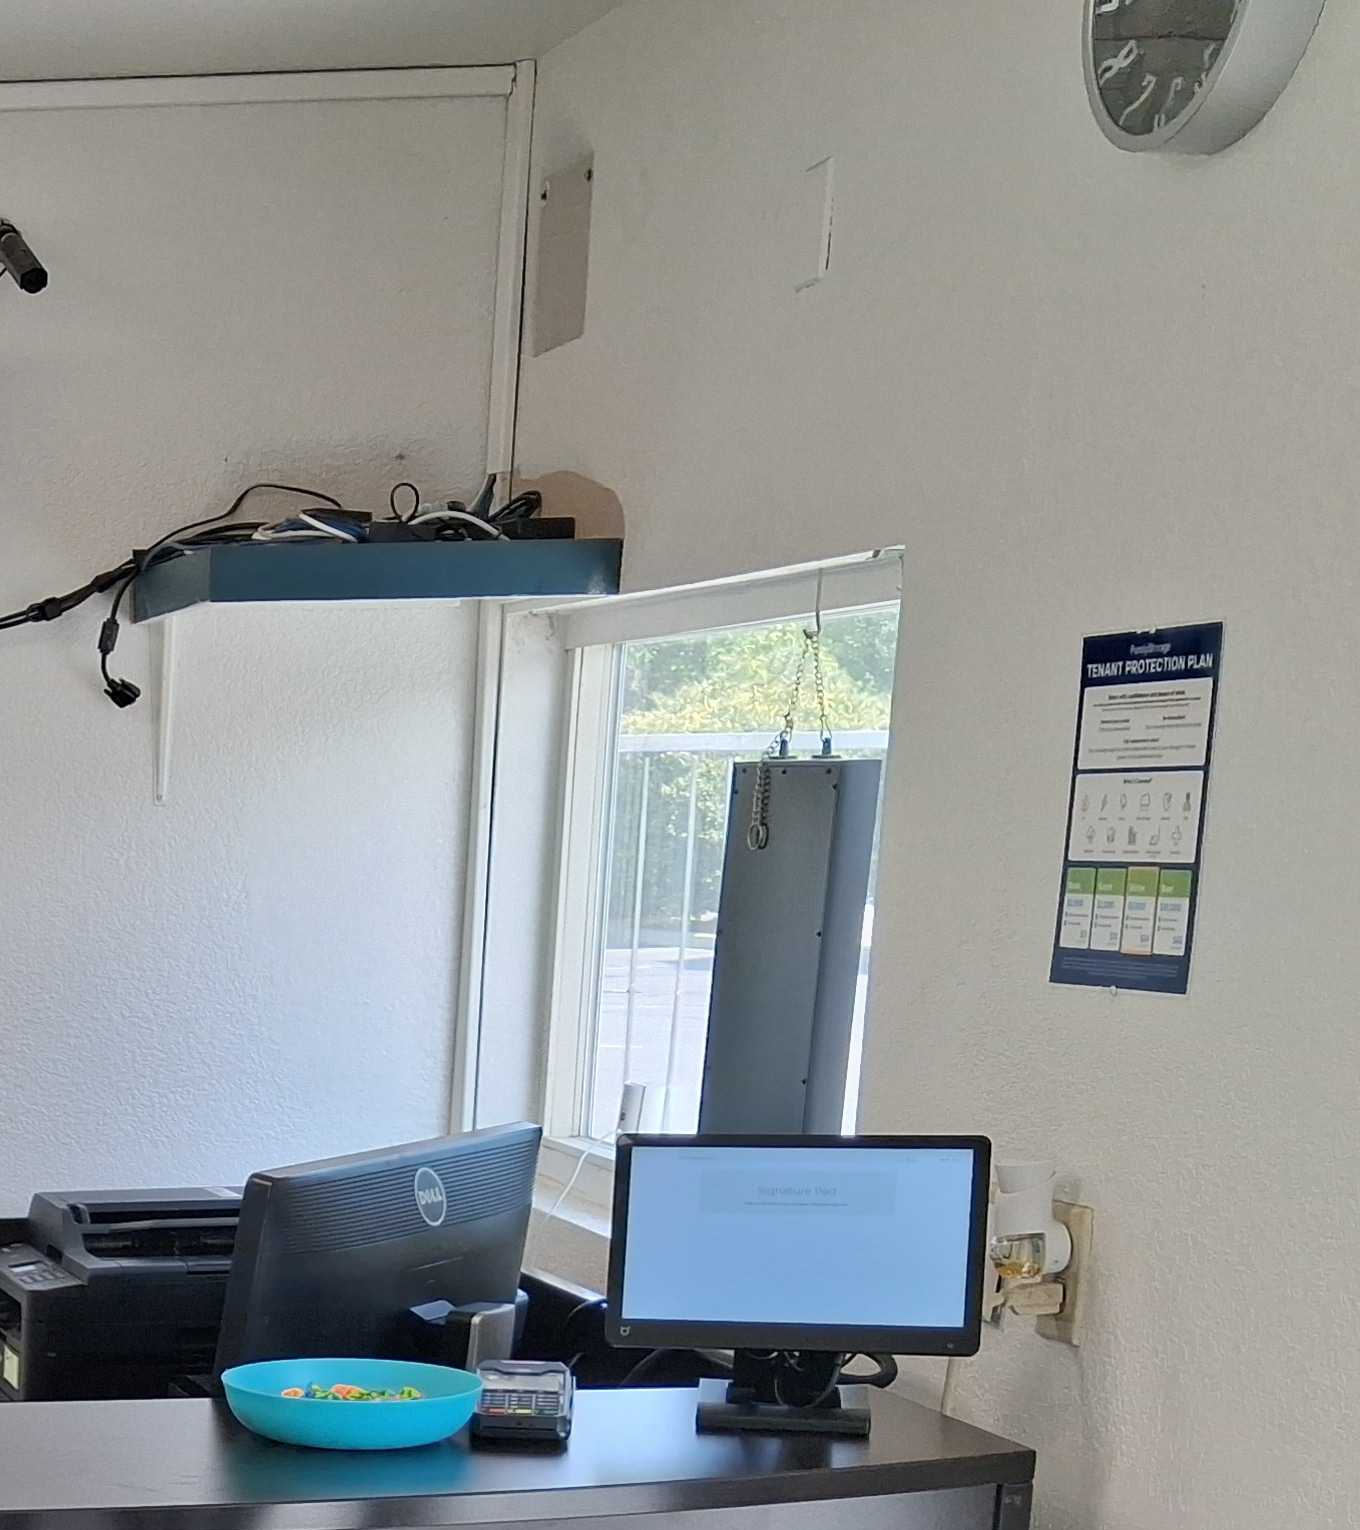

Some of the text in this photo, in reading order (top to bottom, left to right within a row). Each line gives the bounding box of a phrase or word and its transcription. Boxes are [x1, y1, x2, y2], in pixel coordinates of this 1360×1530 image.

[1087, 653, 1213, 678] TENANT PROTECTION PLAN
[418, 1187, 442, 1205] DELL
